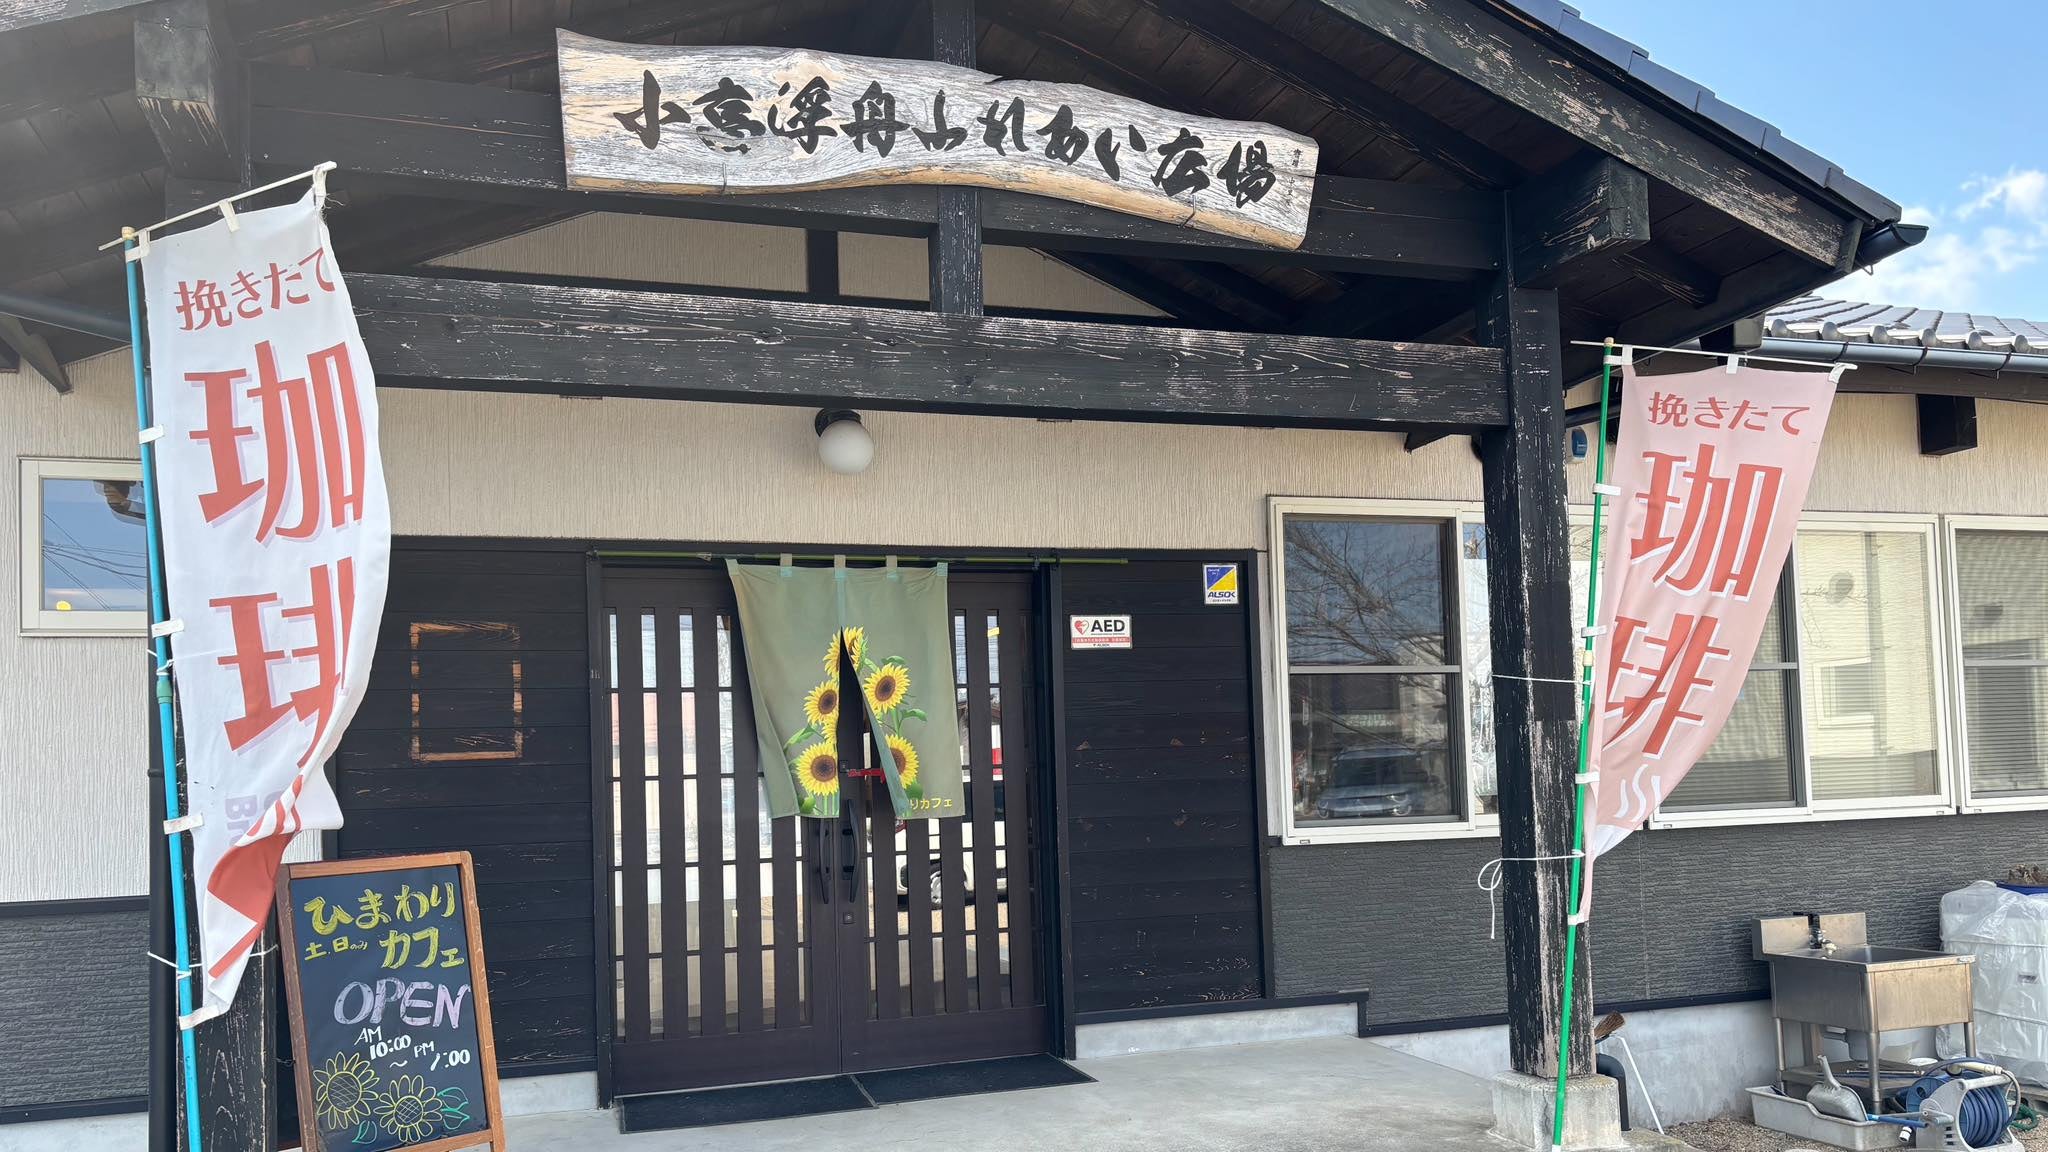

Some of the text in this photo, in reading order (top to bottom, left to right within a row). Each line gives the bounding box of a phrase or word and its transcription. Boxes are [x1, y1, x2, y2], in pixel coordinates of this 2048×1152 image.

[174, 247, 335, 331] 挽きたて
[1648, 391, 1810, 436] 挽きたて
[1602, 444, 1783, 755] 珈琲
[1091, 620, 1125, 632] AED
[304, 882, 455, 935] ひまわり
[379, 926, 465, 969] カフェ
[333, 977, 471, 1028] OPEN
[354, 1026, 383, 1046] AM
[370, 1034, 412, 1060] 10:00
[413, 1040, 434, 1058] PM
